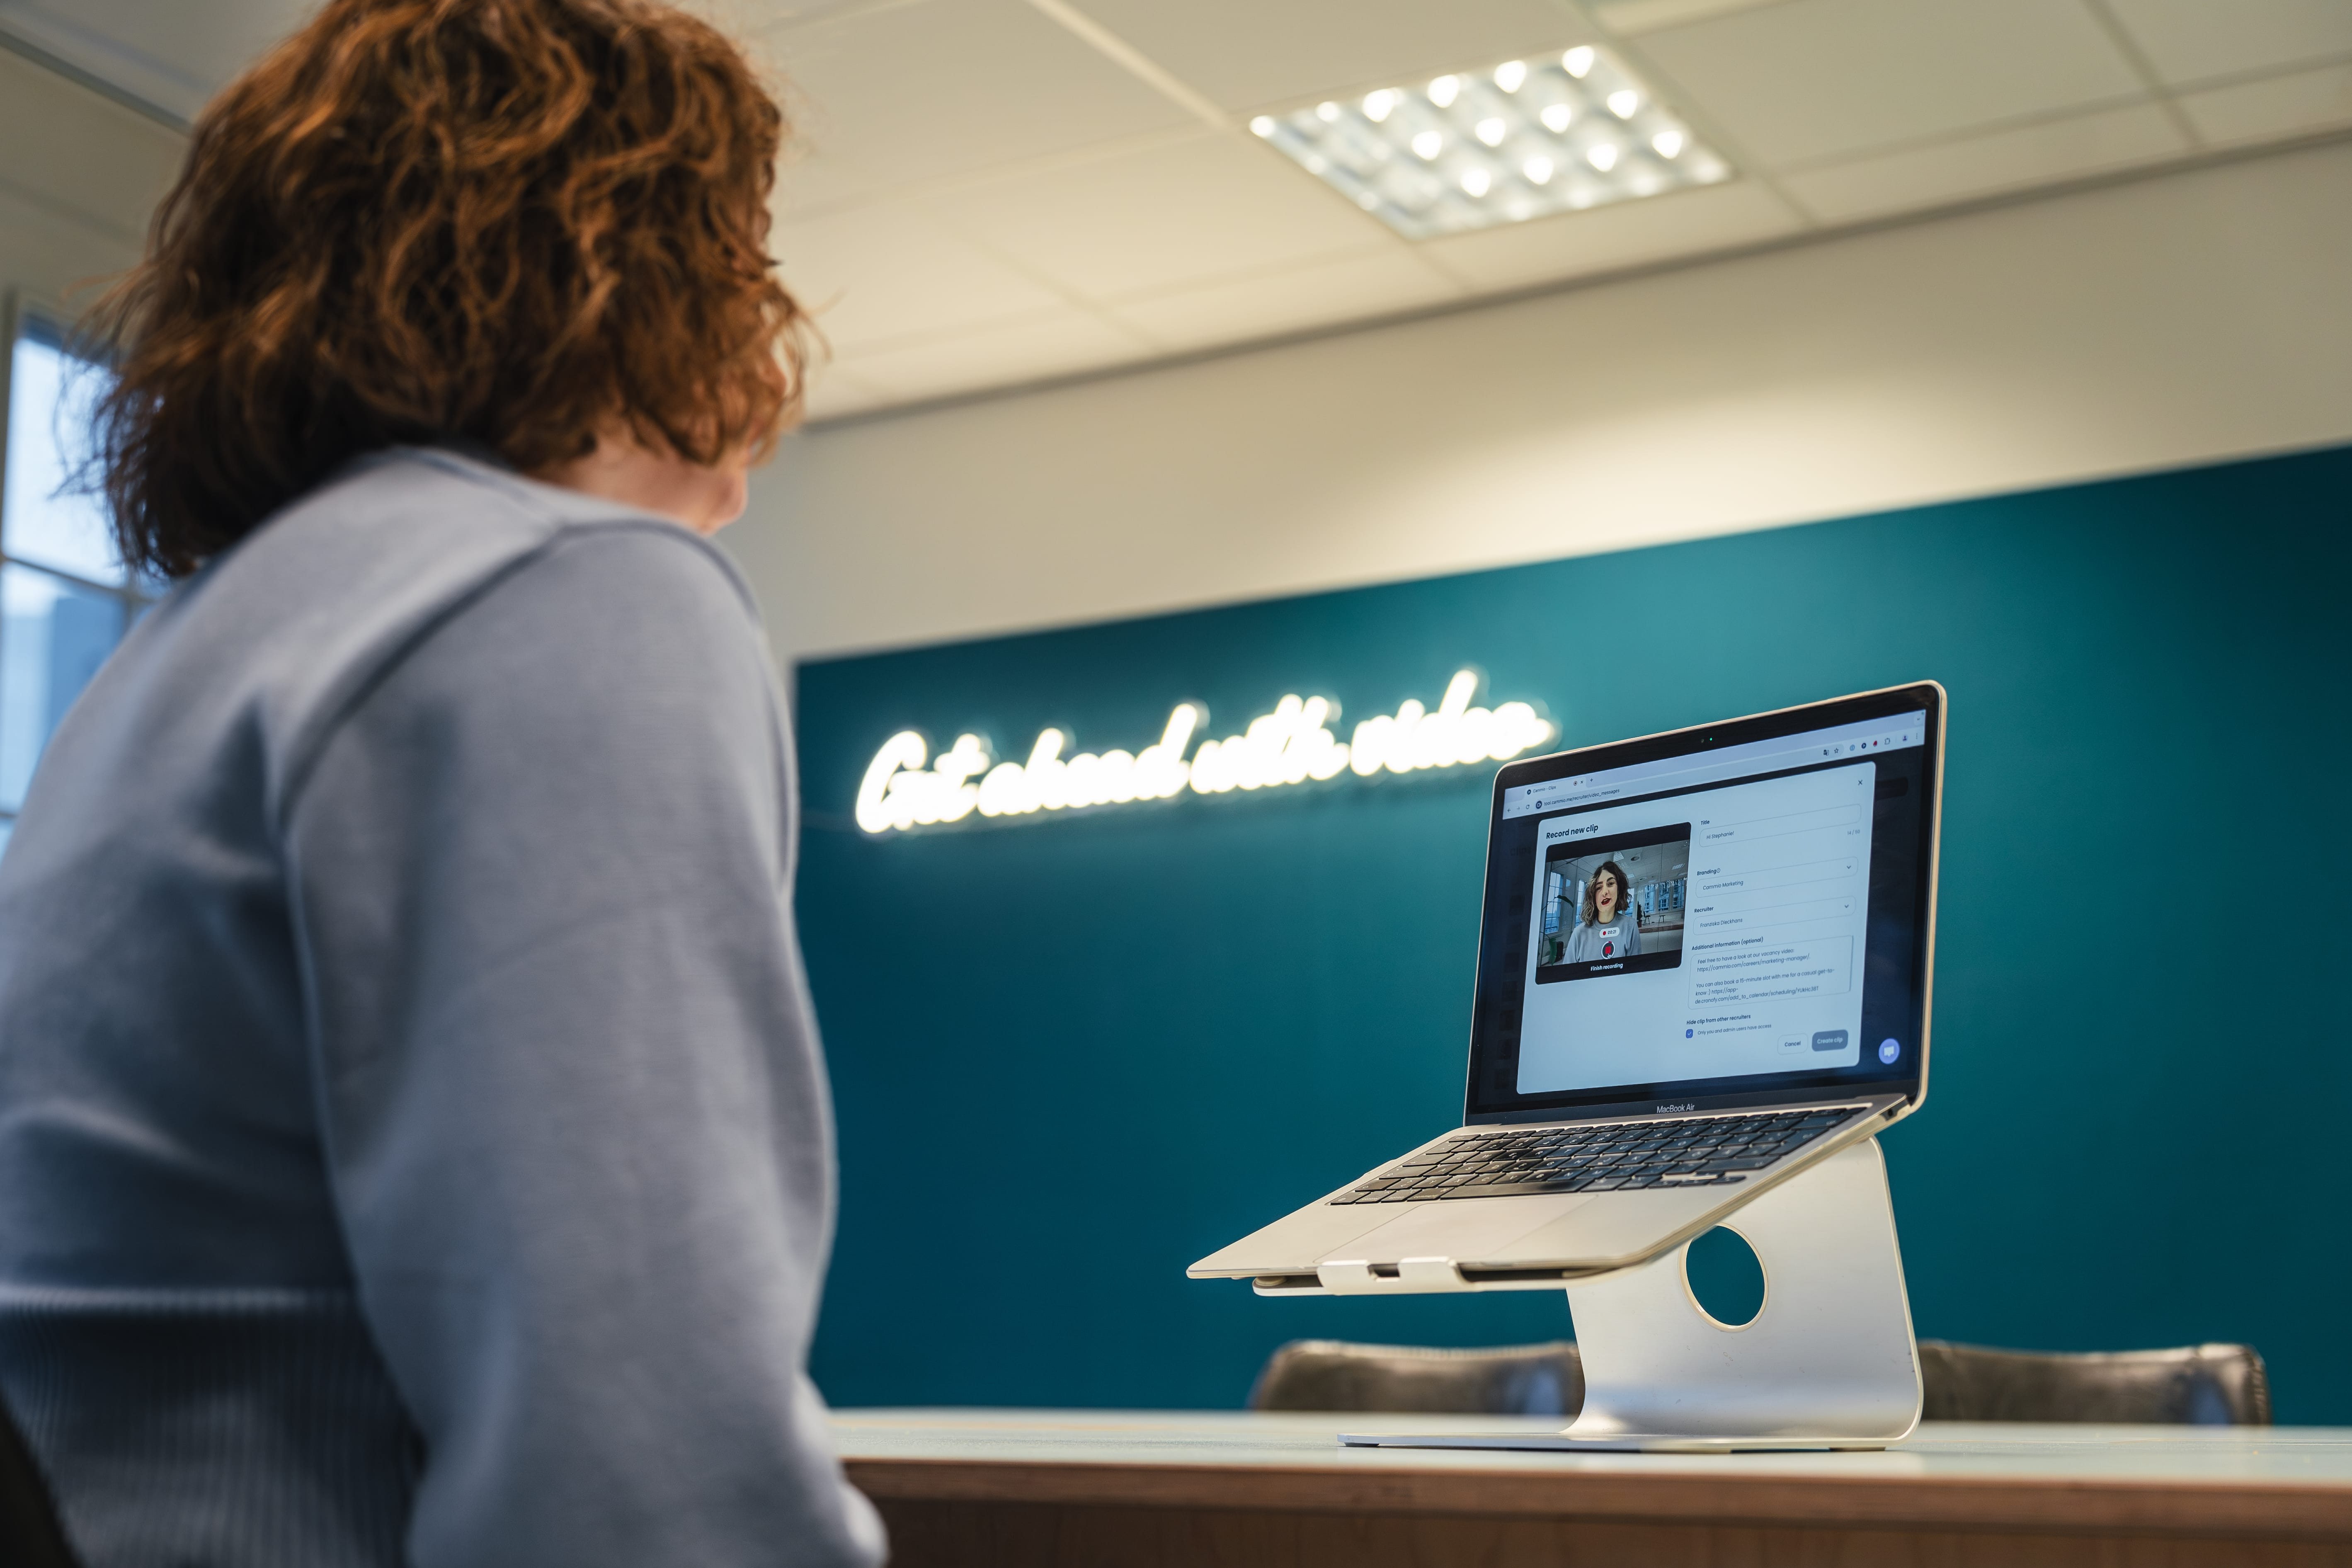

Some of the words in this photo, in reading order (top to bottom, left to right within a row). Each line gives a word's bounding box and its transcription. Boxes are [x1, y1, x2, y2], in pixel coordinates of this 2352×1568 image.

[977, 703, 1197, 817] ahead
[1189, 693, 1351, 794] with
[1350, 669, 1551, 776] video
[1544, 789, 1620, 806] tool.cammio.me/recruiter/video_messages
[1546, 829, 1569, 839] Record
[1571, 826, 1585, 835] new
[1586, 824, 1598, 833] clip
[1712, 831, 1734, 839] Stephanie!
[1722, 880, 1743, 889] Marketing
[1741, 937, 1763, 945] (optional)
[1657, 1104, 1685, 1113] MacBook
